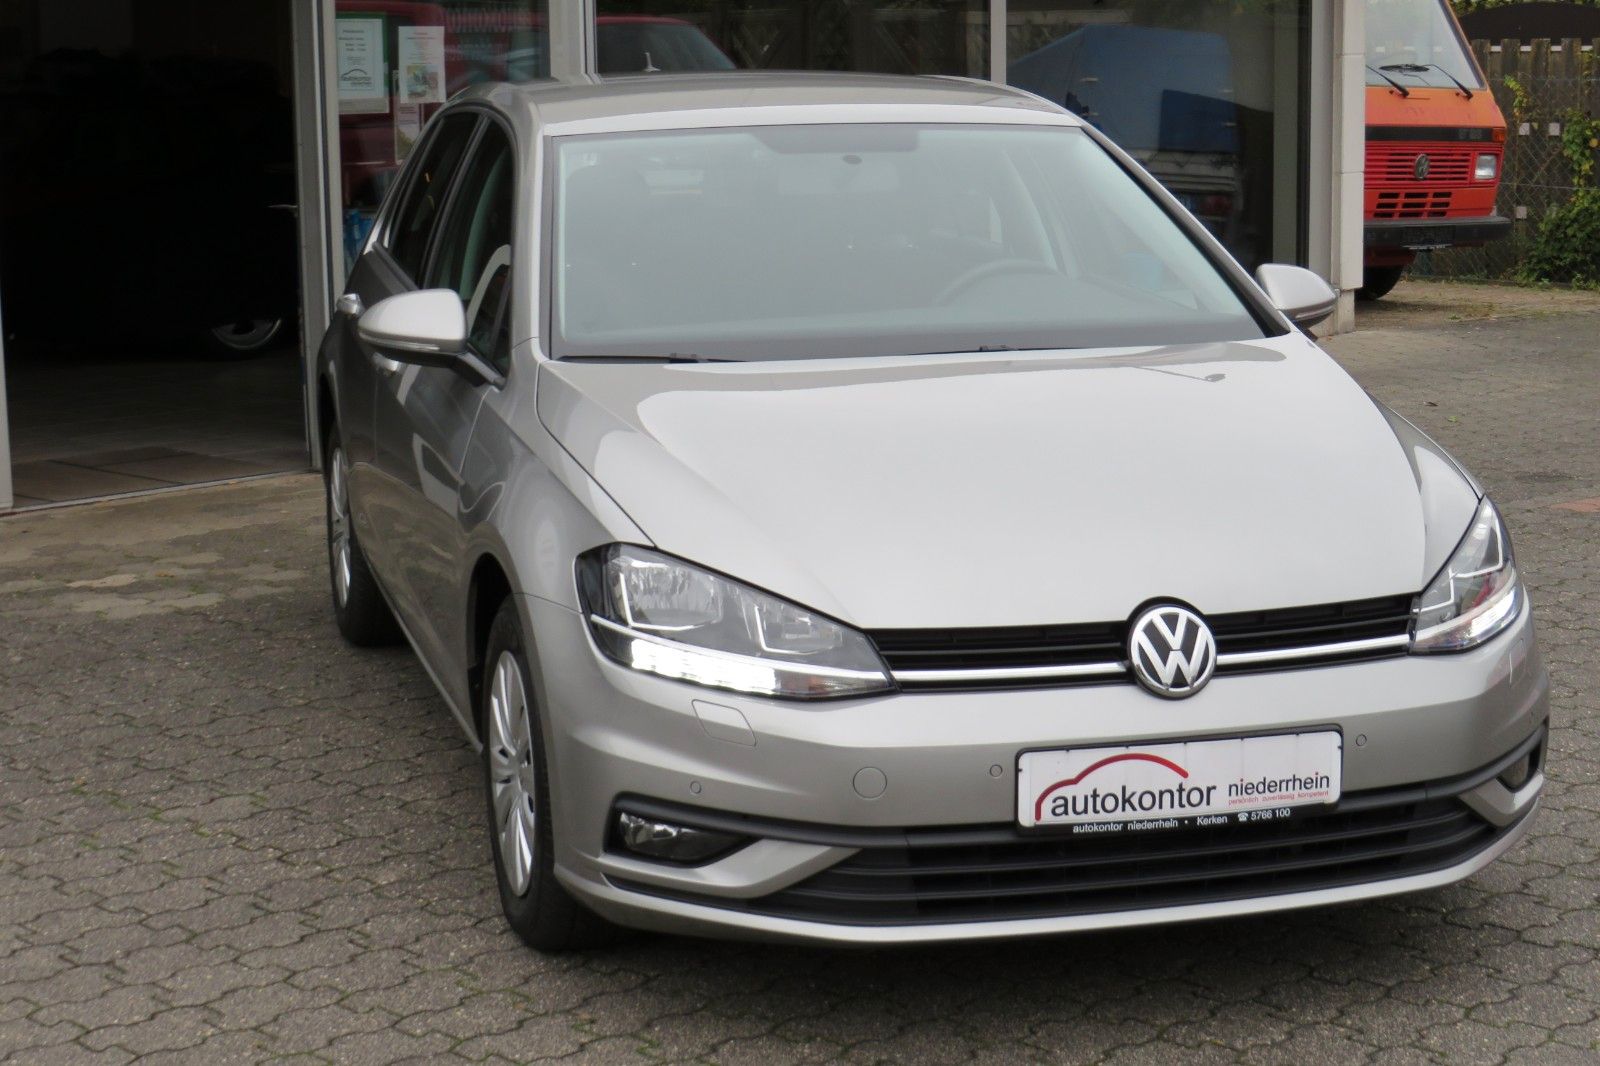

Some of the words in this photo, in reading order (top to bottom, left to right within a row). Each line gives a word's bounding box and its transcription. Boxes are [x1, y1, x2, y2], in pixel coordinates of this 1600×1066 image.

[1130, 606, 1216, 693] VW
[1228, 771, 1330, 797] niederrhein
[1051, 782, 1217, 817] autokontor
[1073, 822, 1124, 833] autokontor
[1127, 819, 1179, 831] niederrhein
[1196, 815, 1229, 826] Kerken
[1275, 807, 1291, 818] 100
